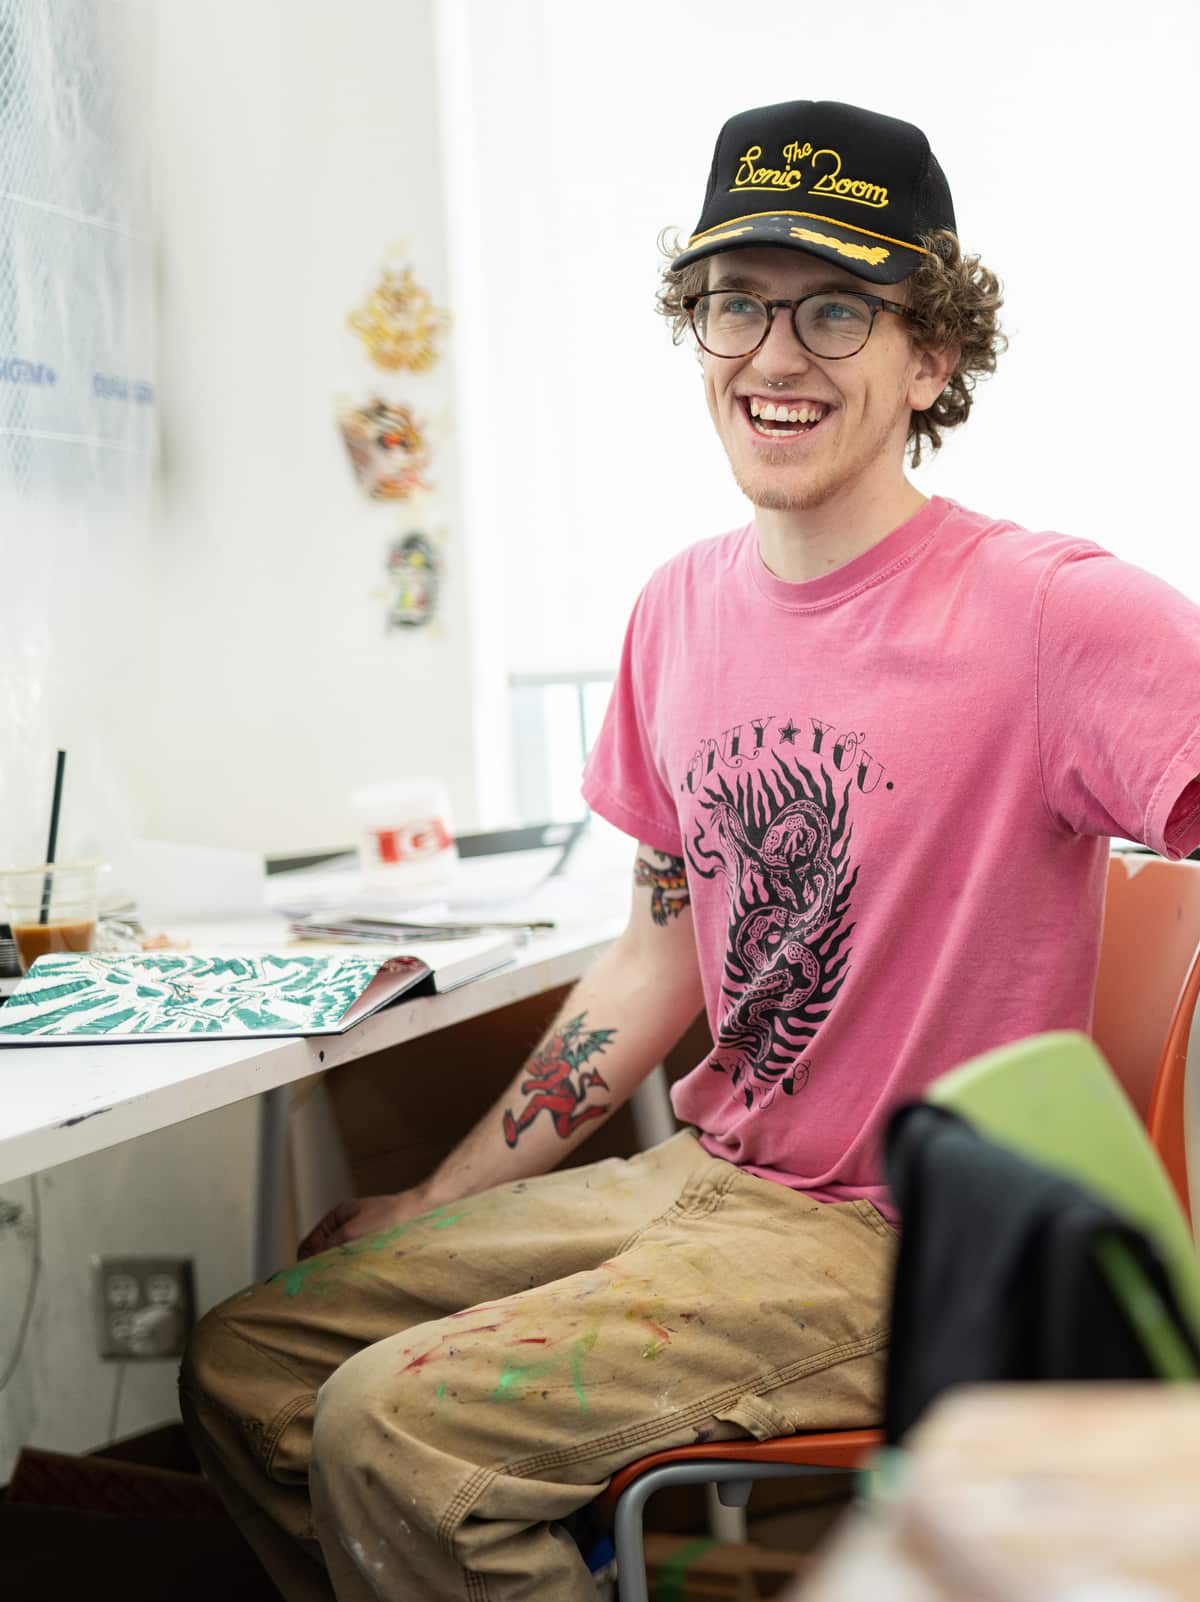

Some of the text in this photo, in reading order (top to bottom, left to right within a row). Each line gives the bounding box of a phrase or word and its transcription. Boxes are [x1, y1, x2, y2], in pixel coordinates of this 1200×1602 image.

[734, 146, 889, 204] Sonic Boom
[783, 142, 813, 163] The
[686, 716, 776, 794] ONLY
